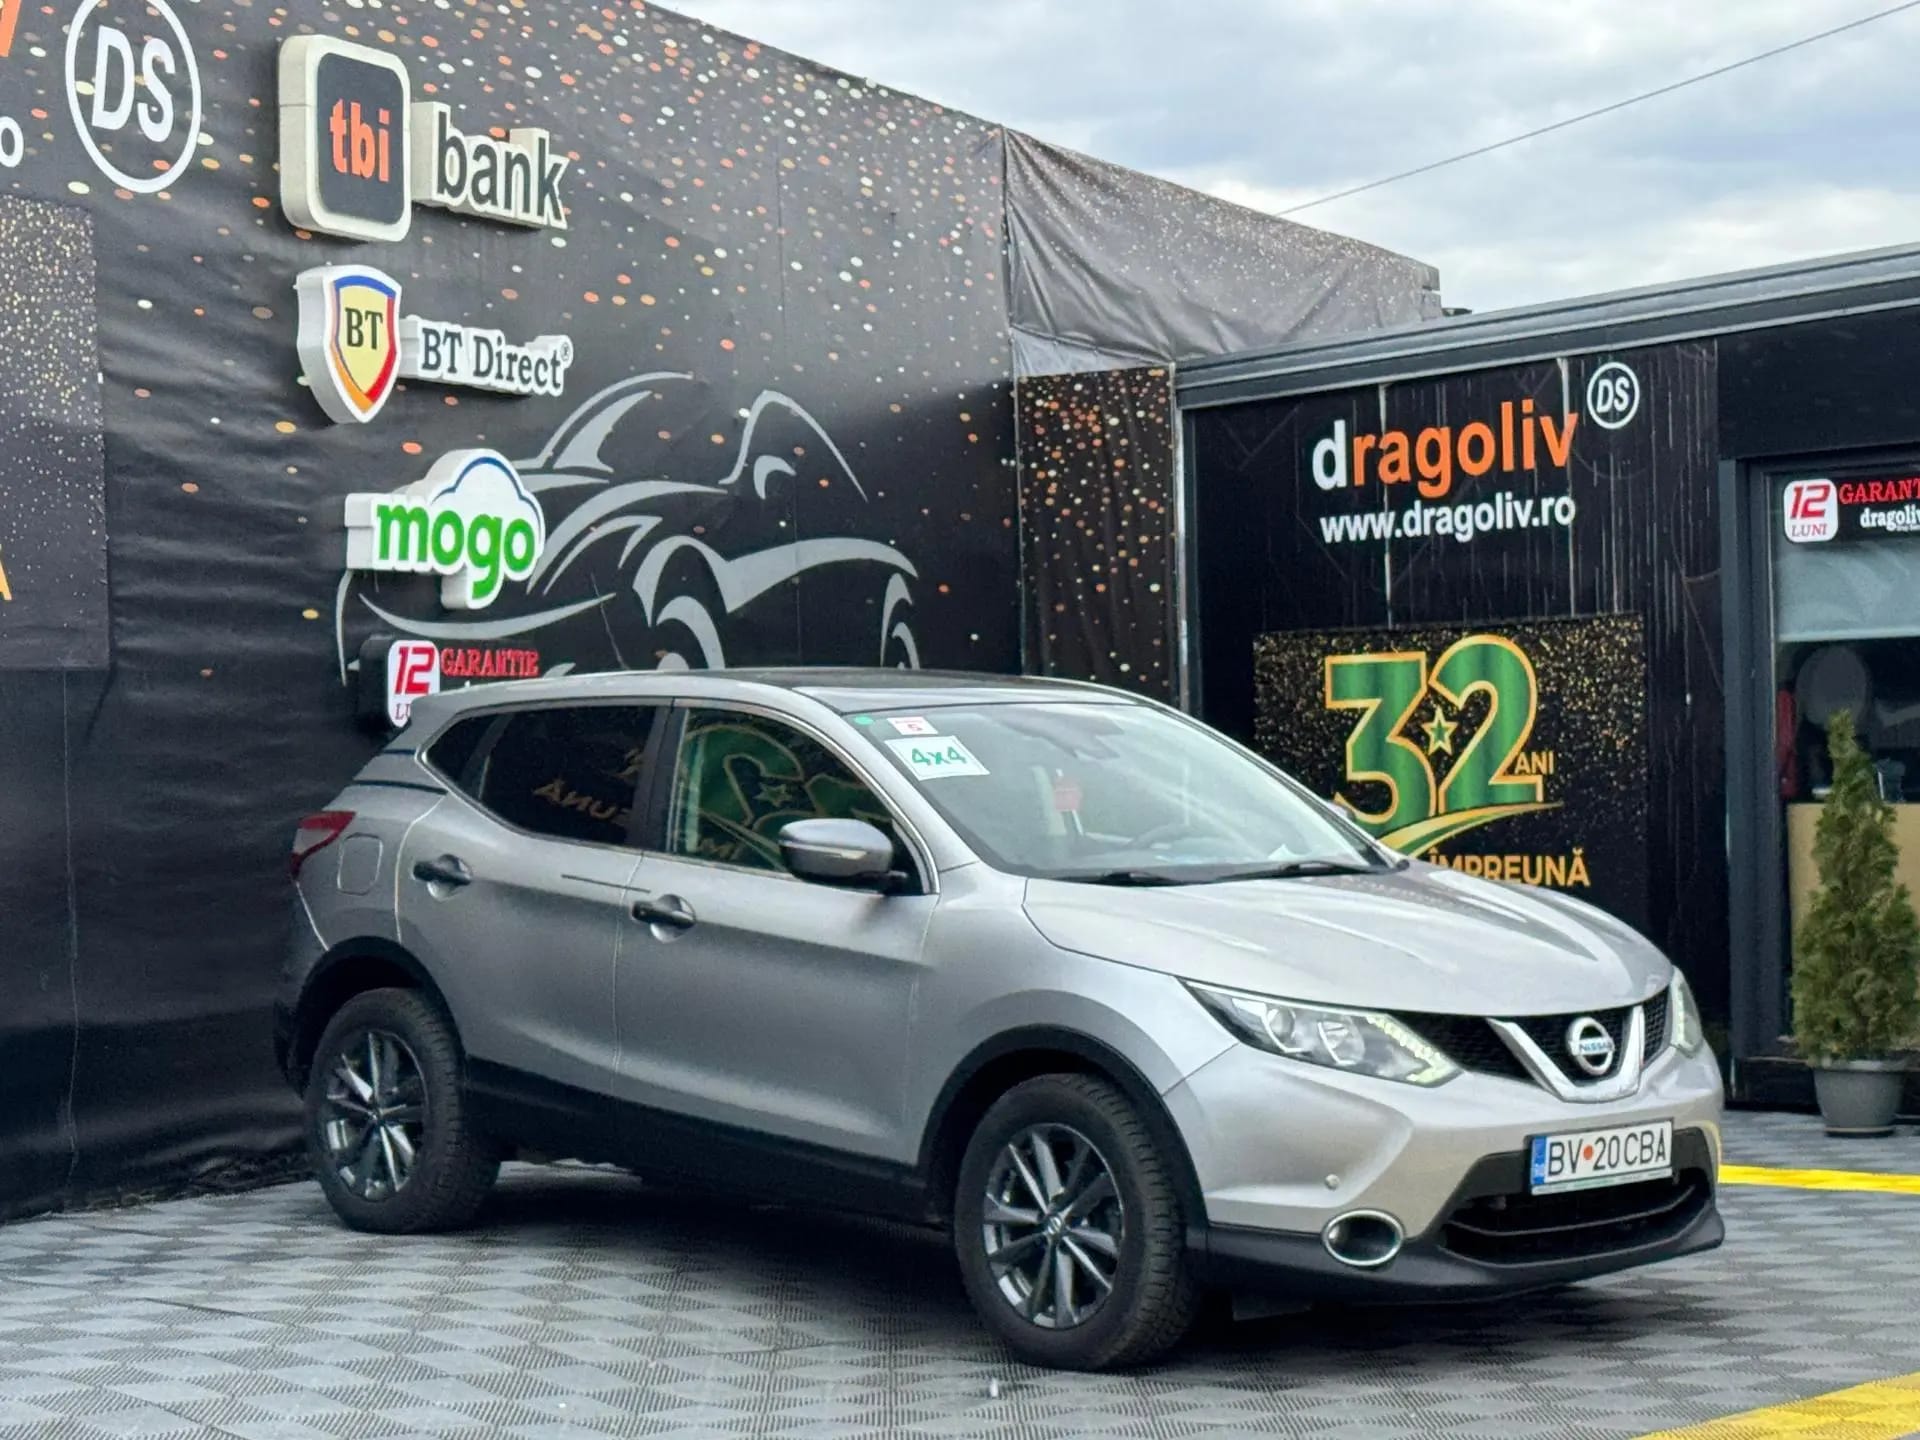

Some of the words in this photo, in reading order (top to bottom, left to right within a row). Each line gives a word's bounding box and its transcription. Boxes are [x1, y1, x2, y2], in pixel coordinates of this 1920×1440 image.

[92, 25, 176, 142] DS
[329, 98, 390, 182] tbi
[437, 111, 562, 221] bank
[345, 307, 383, 350] BT
[422, 327, 462, 374] BT
[1597, 378, 1631, 413] DS
[1312, 398, 1579, 498] dragoliv
[1320, 492, 1577, 544] www.dragoliv.ro
[1790, 484, 1831, 519] 12
[377, 504, 535, 600] mogo
[1791, 523, 1828, 538] LUNI
[394, 646, 436, 695] 12
[440, 647, 540, 677] GARANTIE
[911, 746, 968, 767] 4x4
[1325, 633, 1544, 834] 32
[1514, 751, 1555, 776] ANI
